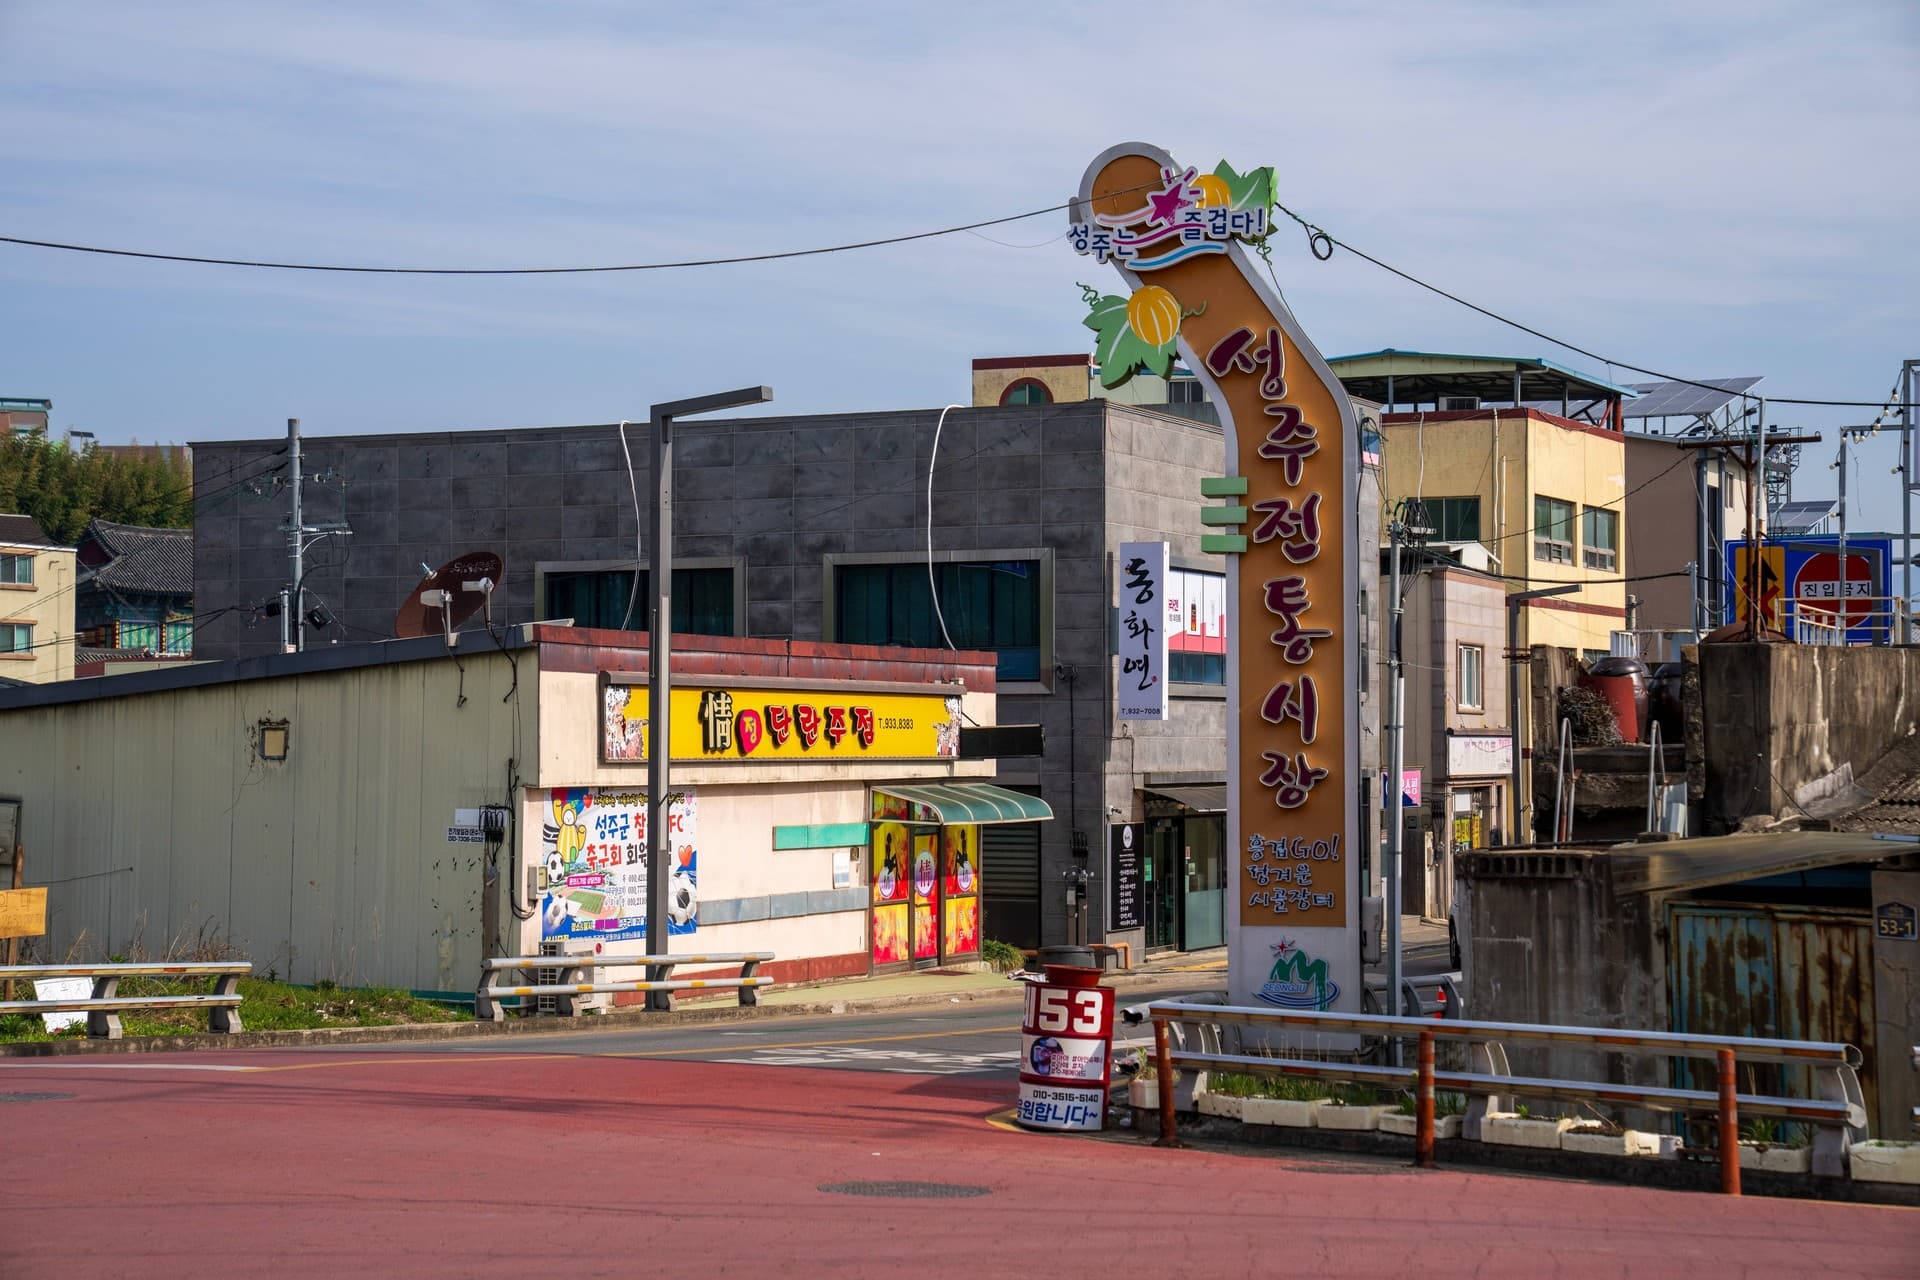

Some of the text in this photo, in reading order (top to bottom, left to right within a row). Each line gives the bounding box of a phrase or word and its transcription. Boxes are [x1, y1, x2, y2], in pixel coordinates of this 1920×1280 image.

[1070, 208, 1264, 260] 성주는 즐겁다!
[1206, 326, 1334, 809] 성주전통시장
[767, 704, 876, 748] 단란주점
[595, 813, 630, 841] 성주군
[586, 843, 622, 871] 축구회
[1247, 863, 1313, 886] 정겨운
[1248, 887, 1335, 913] 시골장터
[1880, 919, 1913, 936] 53-1
